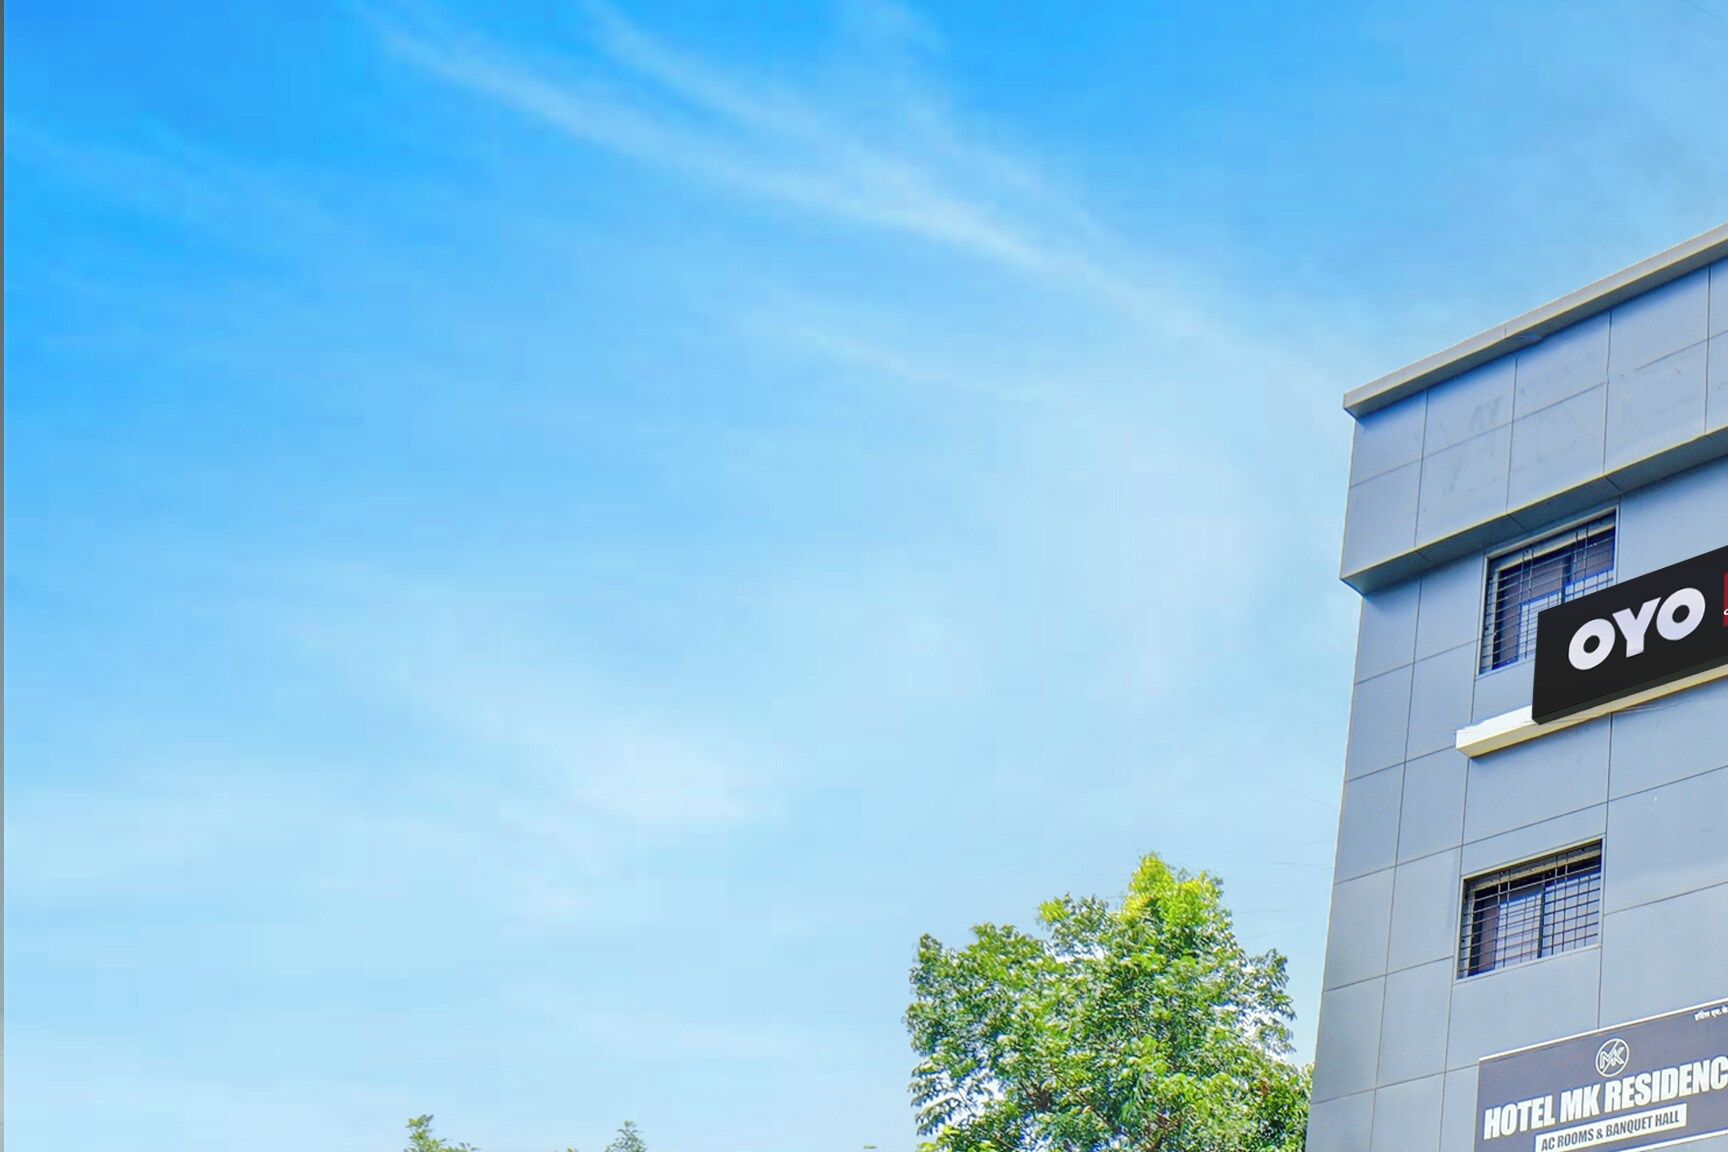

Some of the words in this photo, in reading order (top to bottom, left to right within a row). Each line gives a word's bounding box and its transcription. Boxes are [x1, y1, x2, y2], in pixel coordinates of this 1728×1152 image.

[1568, 587, 1706, 670] OYO
[1483, 1095, 1556, 1140] HOTEL
[1559, 1083, 1601, 1124] MK
[1541, 1135, 1556, 1152] AC
[1557, 1129, 1594, 1149] ROOMS
[1596, 1127, 1604, 1140] &
[1605, 1115, 1653, 1137] BANQUET
[1655, 1109, 1680, 1128] HALL
